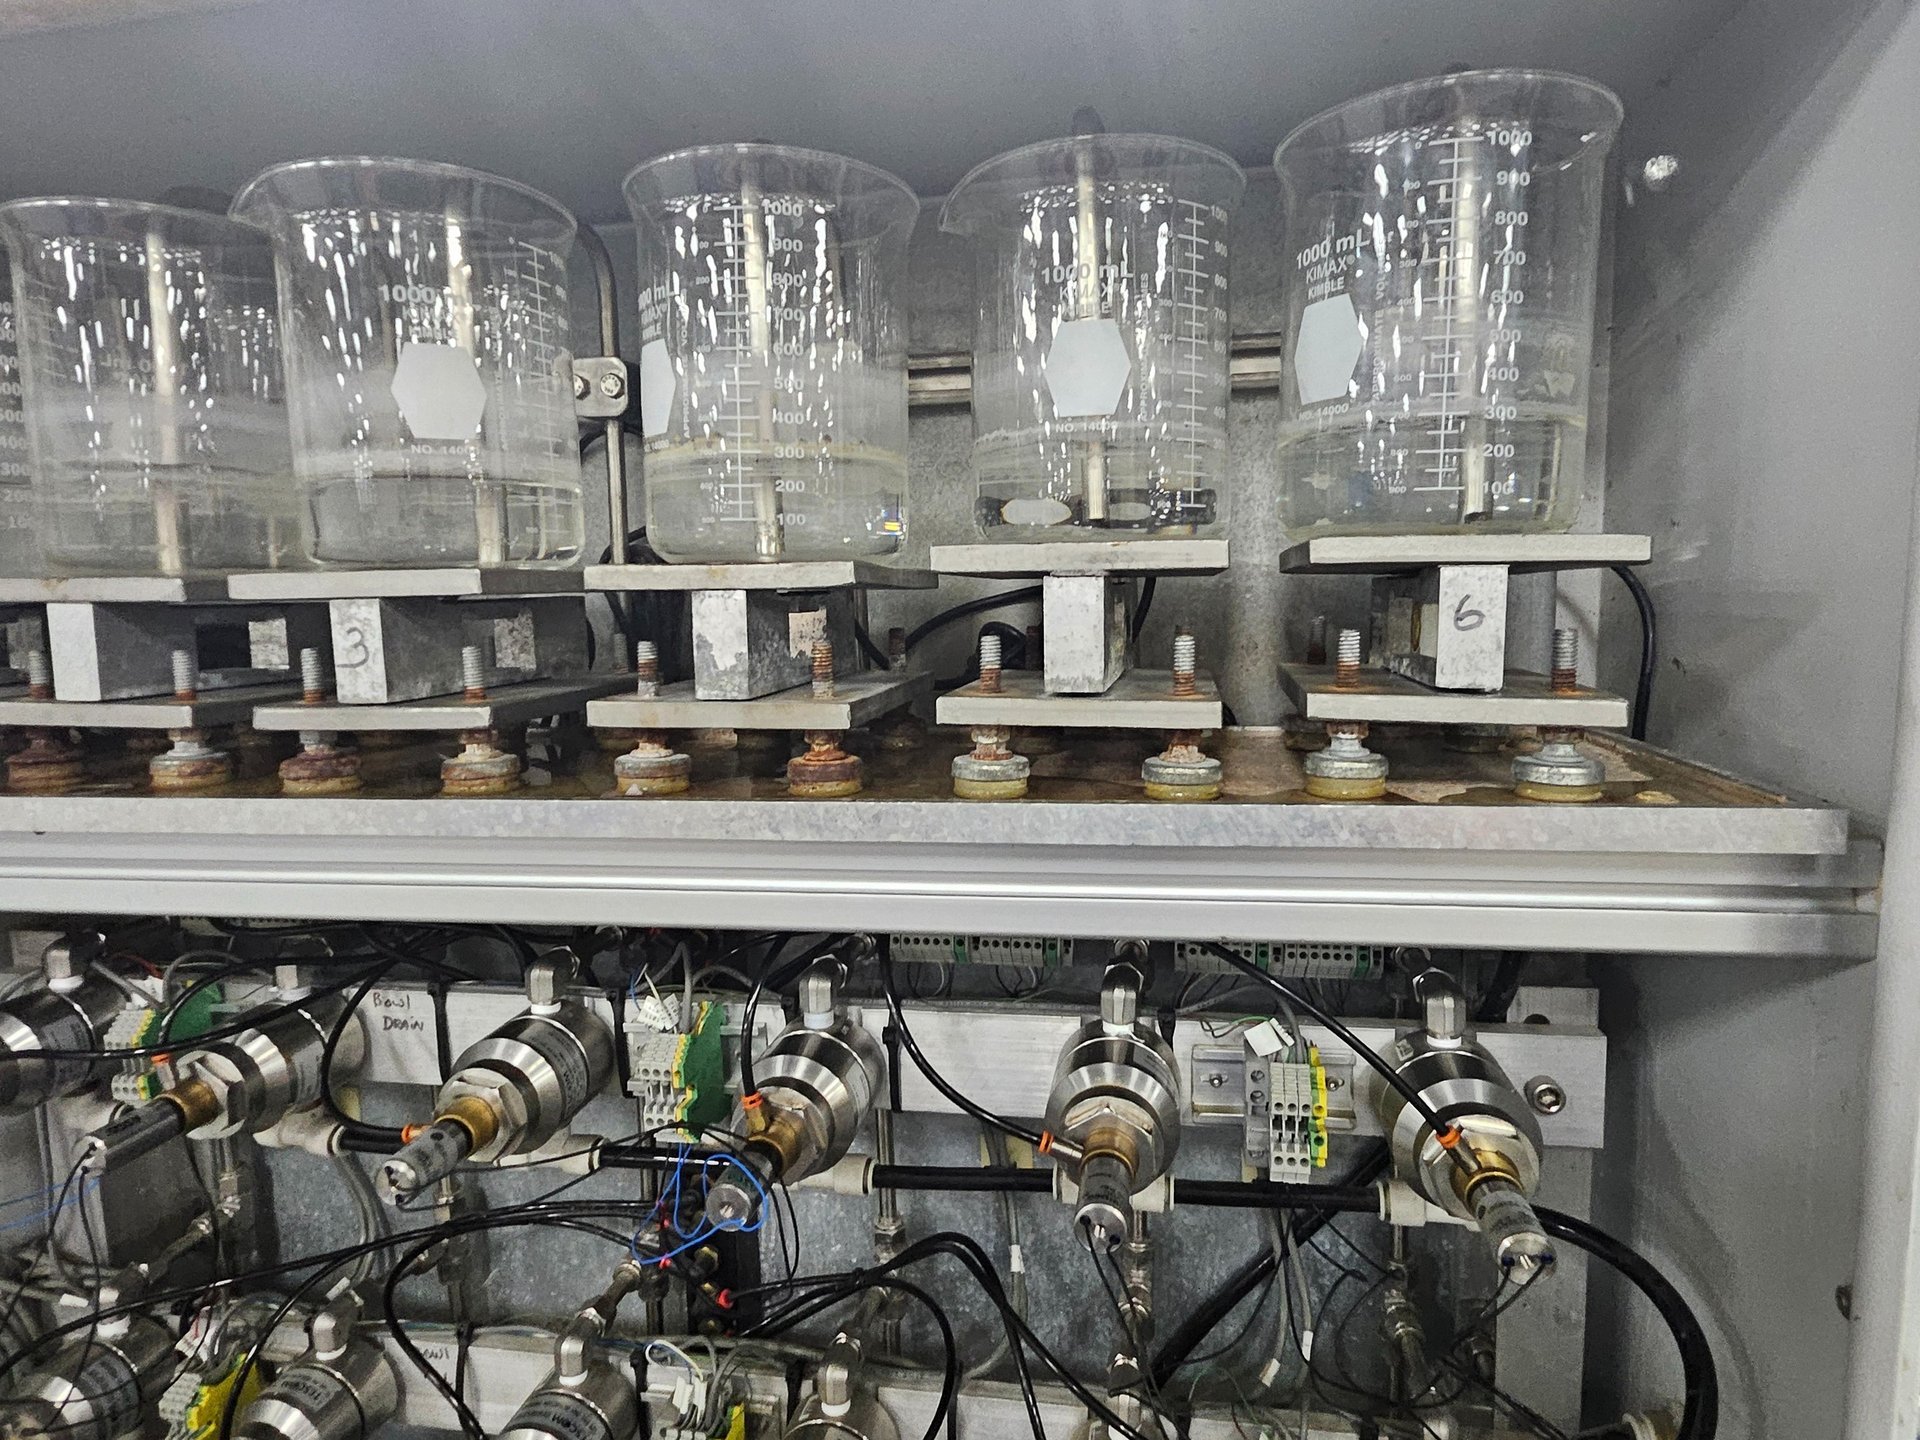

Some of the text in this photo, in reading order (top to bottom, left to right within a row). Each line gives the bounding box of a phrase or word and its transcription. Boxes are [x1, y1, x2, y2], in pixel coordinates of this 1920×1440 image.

[1486, 130, 1532, 146] 1000
[1496, 171, 1530, 186] 900
[763, 200, 803, 217] 1000
[1495, 211, 1528, 226] 800
[773, 238, 803, 252] 900
[1296, 228, 1371, 269] 1000 mL
[1493, 250, 1526, 265] 700
[772, 272, 803, 287] 800
[1042, 263, 1091, 285] 1000
[378, 284, 436, 304] 1000
[1308, 276, 1345, 300] KIMBLE
[1491, 290, 1524, 304] 600
[1489, 329, 1521, 343] 500
[773, 342, 803, 355] 600
[1488, 367, 1519, 382] 400
[774, 376, 804, 390] 500
[1485, 406, 1517, 420] 300
[774, 446, 804, 459] 300
[1483, 444, 1515, 458] 200
[775, 480, 805, 492] 200
[777, 513, 806, 526] 100
[1453, 593, 1486, 632] 6
[336, 626, 370, 669] 3
[373, 992, 411, 1010] Bowl
[422, 1347, 450, 1360] owl
